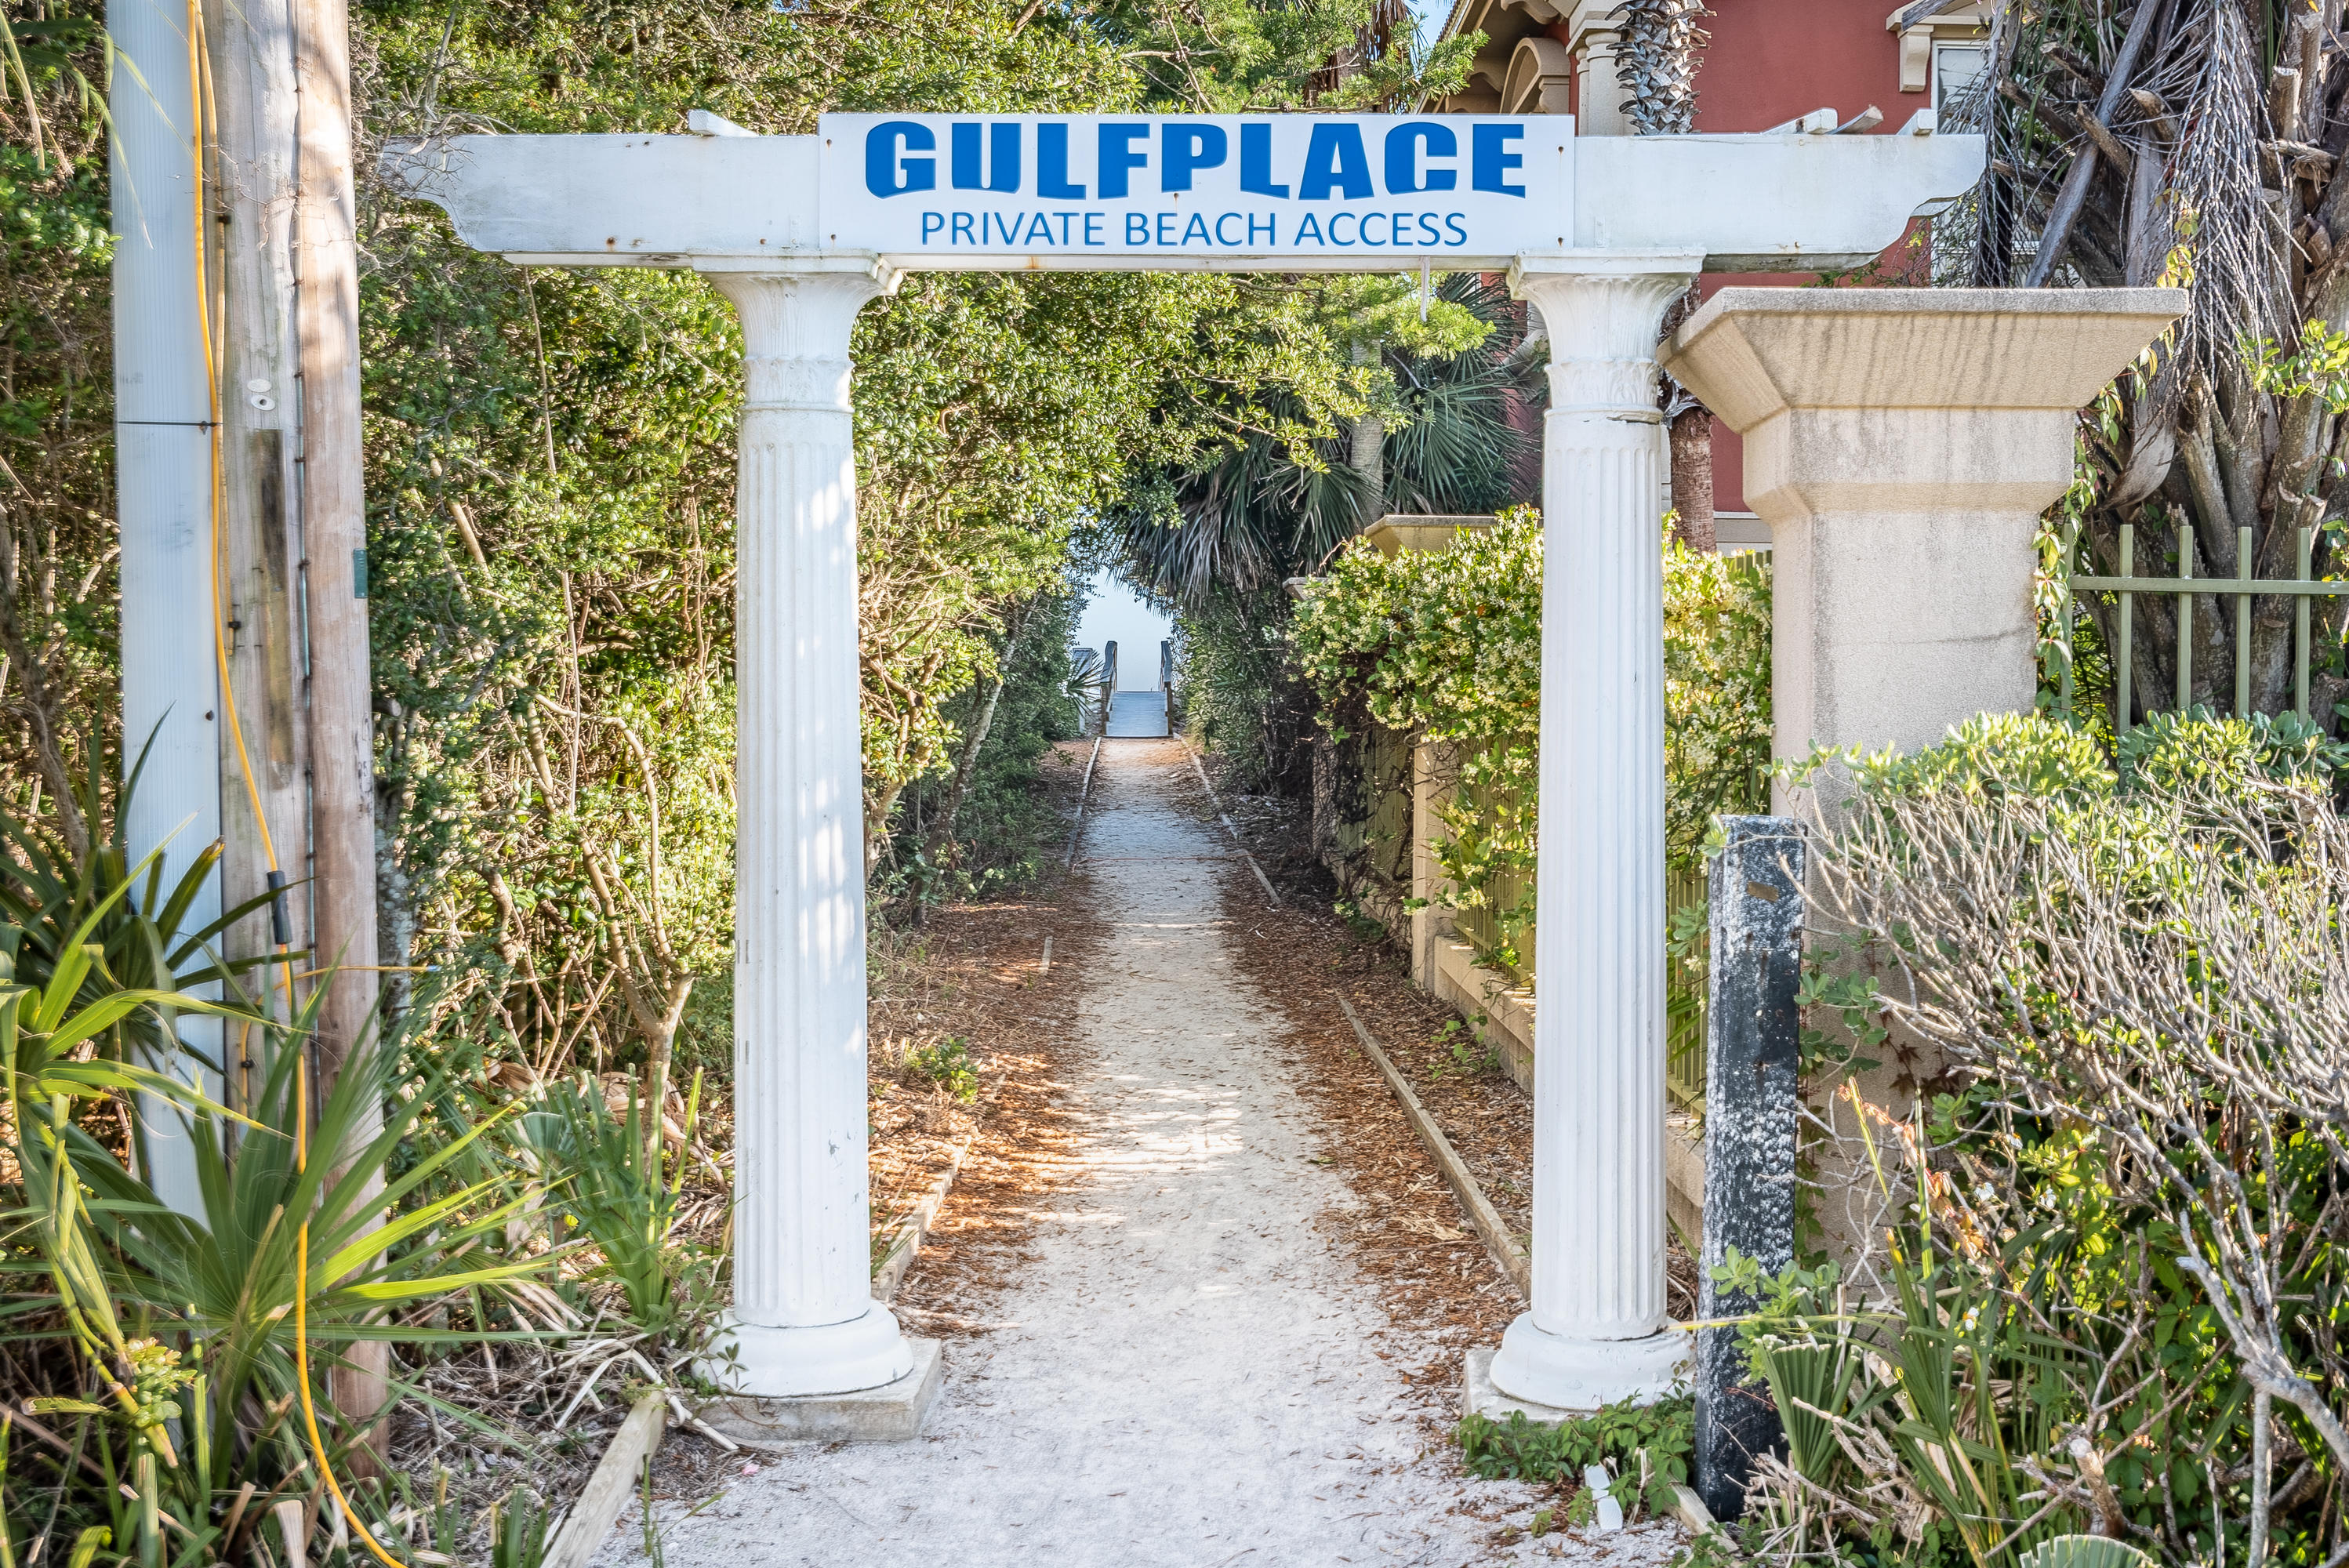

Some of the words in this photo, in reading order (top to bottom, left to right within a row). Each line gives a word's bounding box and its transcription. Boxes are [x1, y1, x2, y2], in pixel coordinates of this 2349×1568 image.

[865, 121, 1526, 201] GULFPLACE
[921, 212, 1106, 246] PRIVATE
[1125, 212, 1276, 247] BEACH
[1294, 212, 1468, 247] ACCESS
